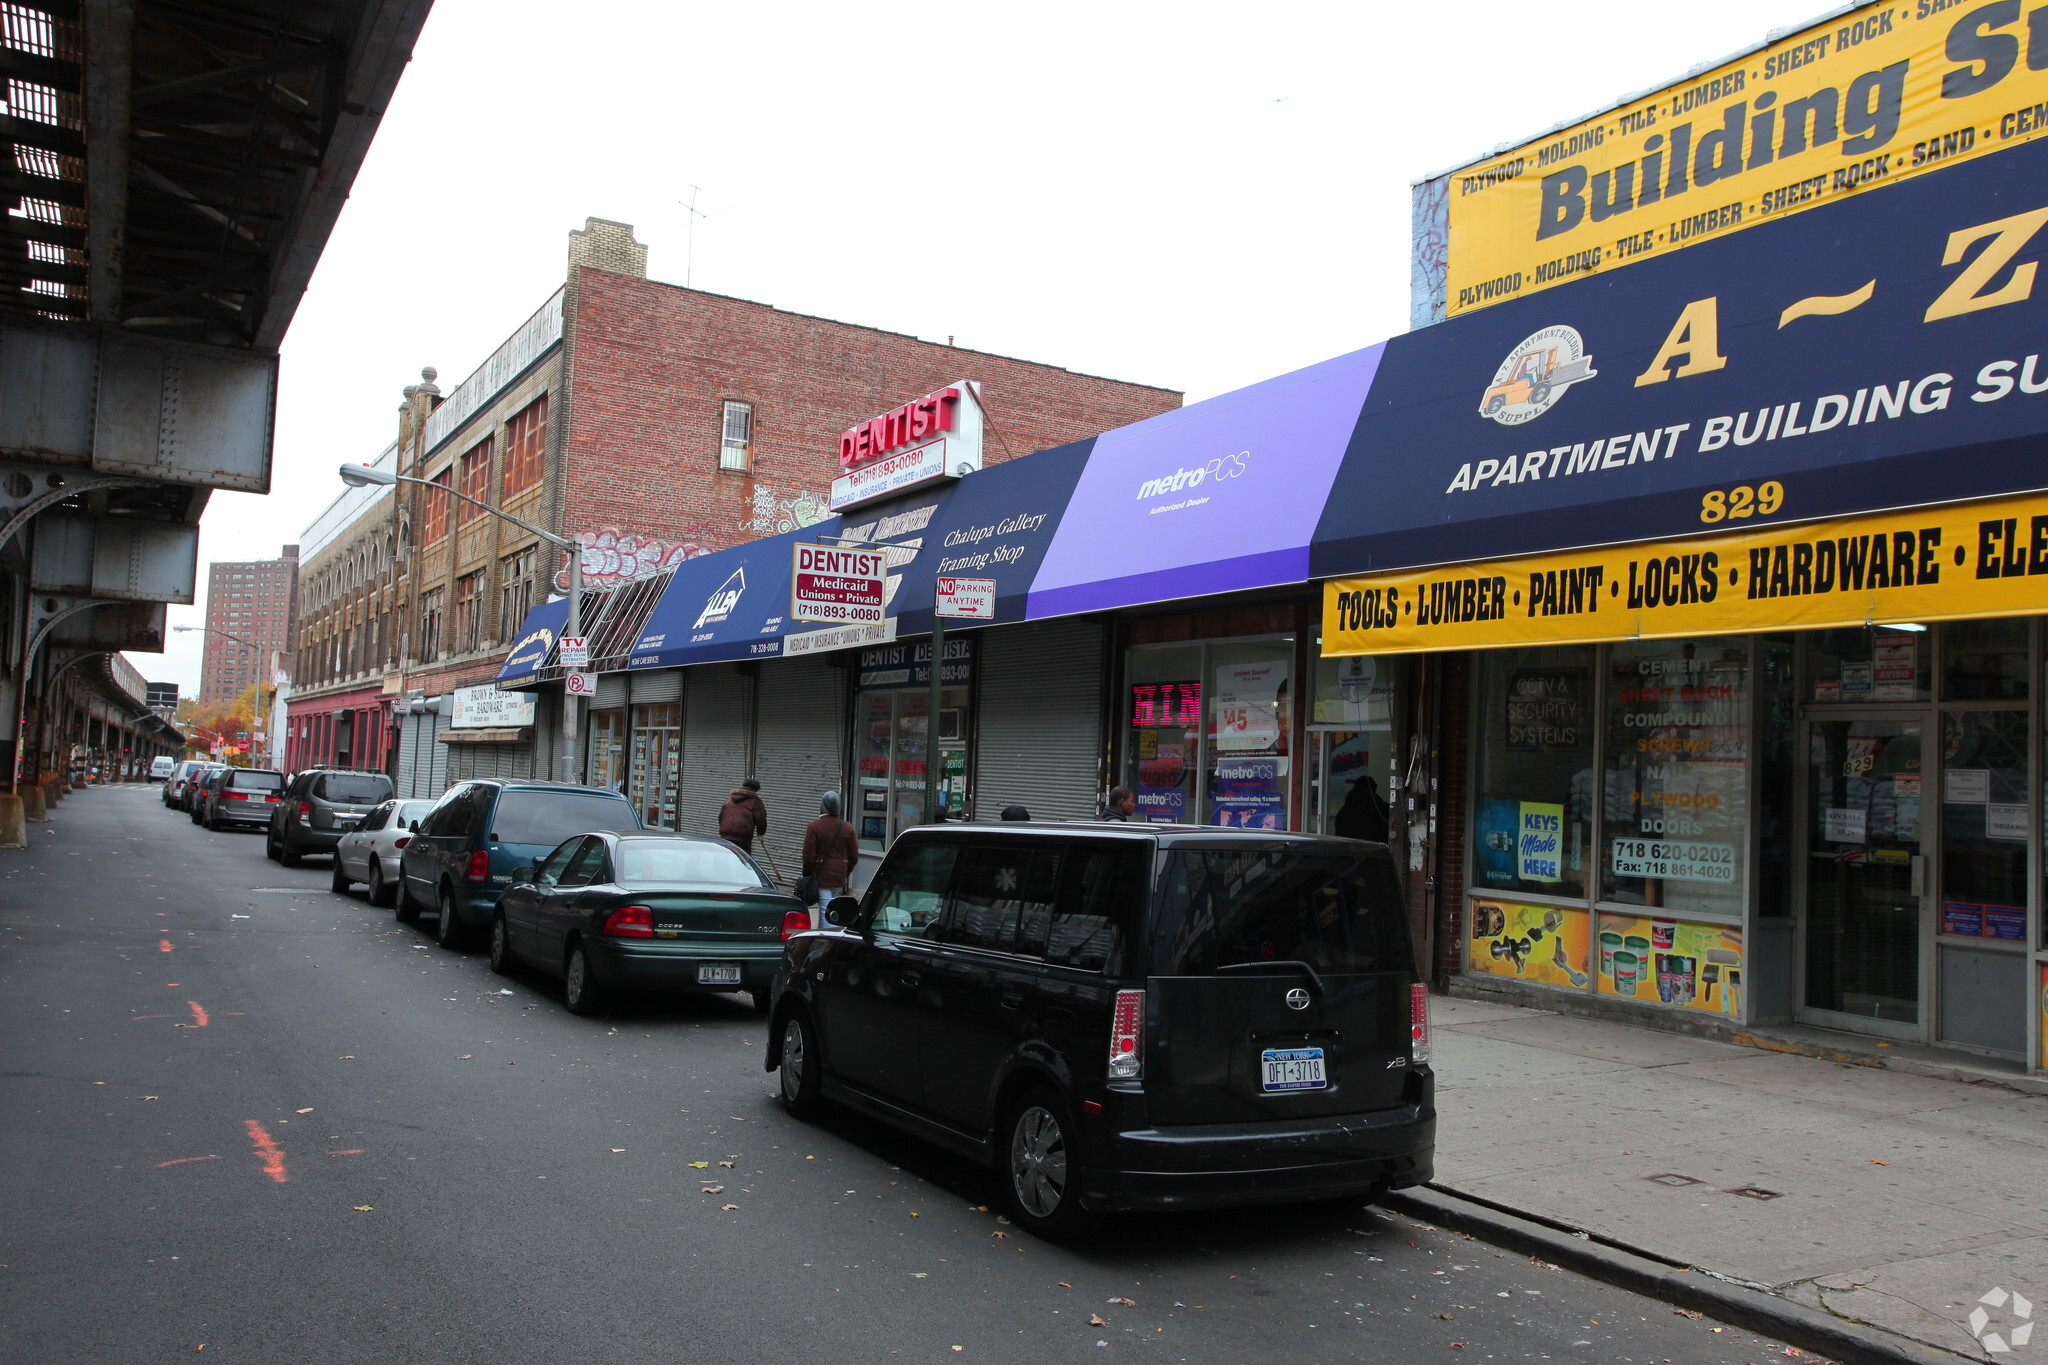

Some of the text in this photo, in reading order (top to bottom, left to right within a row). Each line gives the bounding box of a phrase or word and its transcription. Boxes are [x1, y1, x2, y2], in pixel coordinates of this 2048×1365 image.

[1462, 157, 1524, 197] PLYWOOD
[1537, 126, 1605, 168] MOLDING
[1619, 105, 1657, 136] TILE
[1672, 69, 1745, 117] LUMBER
[1764, 34, 1830, 80] SHEET
[1836, 8, 1895, 53] ROCK
[1536, 58, 1910, 242] Building
[1459, 272, 1521, 307] PLYWOOD
[1535, 247, 1602, 285] MOLDING
[1616, 229, 1654, 259] TILE
[1669, 201, 1741, 243] LUMBER
[1761, 174, 1827, 215] SHEET
[1832, 154, 1890, 192] ROCK
[1912, 126, 1975, 167] SAND
[1634, 296, 1727, 388] A
[1924, 204, 2048, 323] Z
[1510, 329, 1561, 362] APARTMENT
[1560, 329, 1579, 361] BUILDING
[1498, 398, 1550, 422] SUPPLY
[839, 387, 960, 468] DENTIST
[1446, 423, 1690, 494] APARTMENT
[1698, 371, 1954, 453] BUILDING
[860, 481, 887, 498] INSURANCE
[893, 471, 914, 486] PRIVATE
[920, 462, 941, 478] UNIONS
[1136, 450, 1250, 500] metroPCS
[1149, 496, 1211, 516] Authorized Dealer
[1700, 480, 1784, 524] 829
[944, 511, 1048, 548] Chalupa Gallery
[800, 549, 882, 576] DENTIST
[936, 549, 990, 574] Framing
[990, 544, 1025, 566] Shop
[813, 577, 868, 592] Medicaid
[940, 580, 993, 593] NO PARKING
[1337, 586, 1398, 632] TOOLS
[1416, 575, 1507, 626] LUMBER
[1527, 565, 1604, 618] PAINT
[1627, 552, 1718, 609] LOCKS
[1747, 527, 1942, 600] HARDWARE
[800, 589, 880, 604] Unions Private
[947, 597, 984, 606] ANYTIME
[692, 588, 743, 630] ALLEN
[562, 638, 584, 647] TV
[1875, 637, 1913, 646] WARNING
[861, 647, 906, 667] DENTIST
[1639, 660, 1711, 675] CEMENT
[1879, 670, 1909, 679] AVISO
[1517, 676, 1568, 694] CCTV &
[1618, 685, 1734, 702] SHEET ROCK
[1507, 702, 1577, 720] SECURITY
[1624, 712, 1727, 727] COMPOUND
[1509, 727, 1575, 744] SYSTEMS
[1635, 738, 1711, 753] SCREWS
[947, 760, 964, 769] DENTIST
[1221, 765, 1273, 779] metroPCS
[1844, 757, 1872, 775] 829
[1138, 793, 1181, 806] metroPCS
[1630, 792, 1718, 808] PLYWOOD
[1525, 813, 1558, 831] KEYS
[1641, 819, 1703, 835] DOORS
[1520, 832, 1556, 856] Made
[1616, 842, 1731, 863] 718 620-0202
[1523, 859, 1555, 877] HERE
[1616, 860, 1731, 879] Fax: 718 861-4020
[1293, 1052, 1309, 1060] YORK
[1269, 1061, 1320, 1082] DFT 3718
